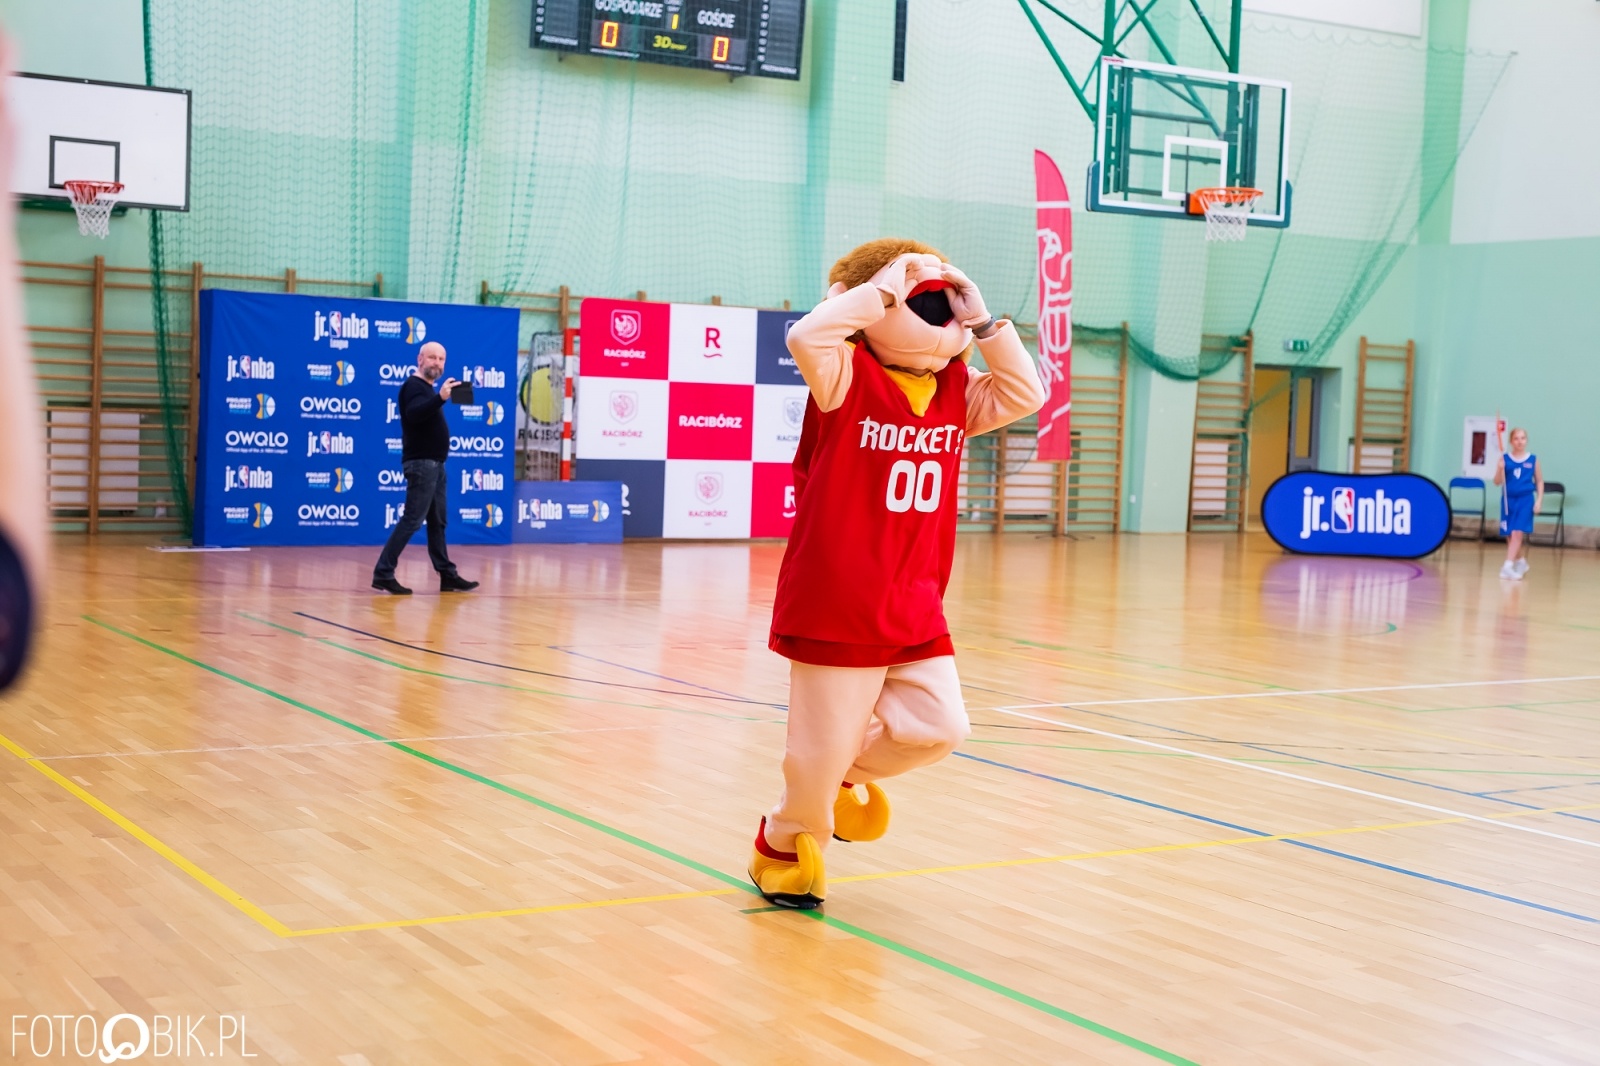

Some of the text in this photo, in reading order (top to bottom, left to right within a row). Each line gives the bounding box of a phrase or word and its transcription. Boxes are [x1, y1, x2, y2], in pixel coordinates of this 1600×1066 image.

[595, 0, 663, 18] GOSPODARZE
[697, 8, 736, 29] GOŚCIE
[601, 21, 619, 47] 0
[712, 36, 730, 61] 0
[342, 312, 369, 339] nba
[705, 327, 721, 349] R
[251, 356, 275, 380] nba
[462, 365, 505, 389] jr nba
[300, 397, 361, 413] OWQLO
[678, 413, 743, 429] RACIBÓRZ
[225, 430, 289, 447] OWQLO
[331, 431, 354, 454] nba
[449, 436, 504, 452] OWQLO
[518, 427, 576, 441] RACIBÓZ
[249, 466, 273, 489] nba
[483, 469, 504, 491] nba
[886, 459, 942, 513] 00
[298, 504, 360, 520] OWQLO
[540, 499, 562, 520] nba
[1300, 486, 1411, 539] jr. nba
